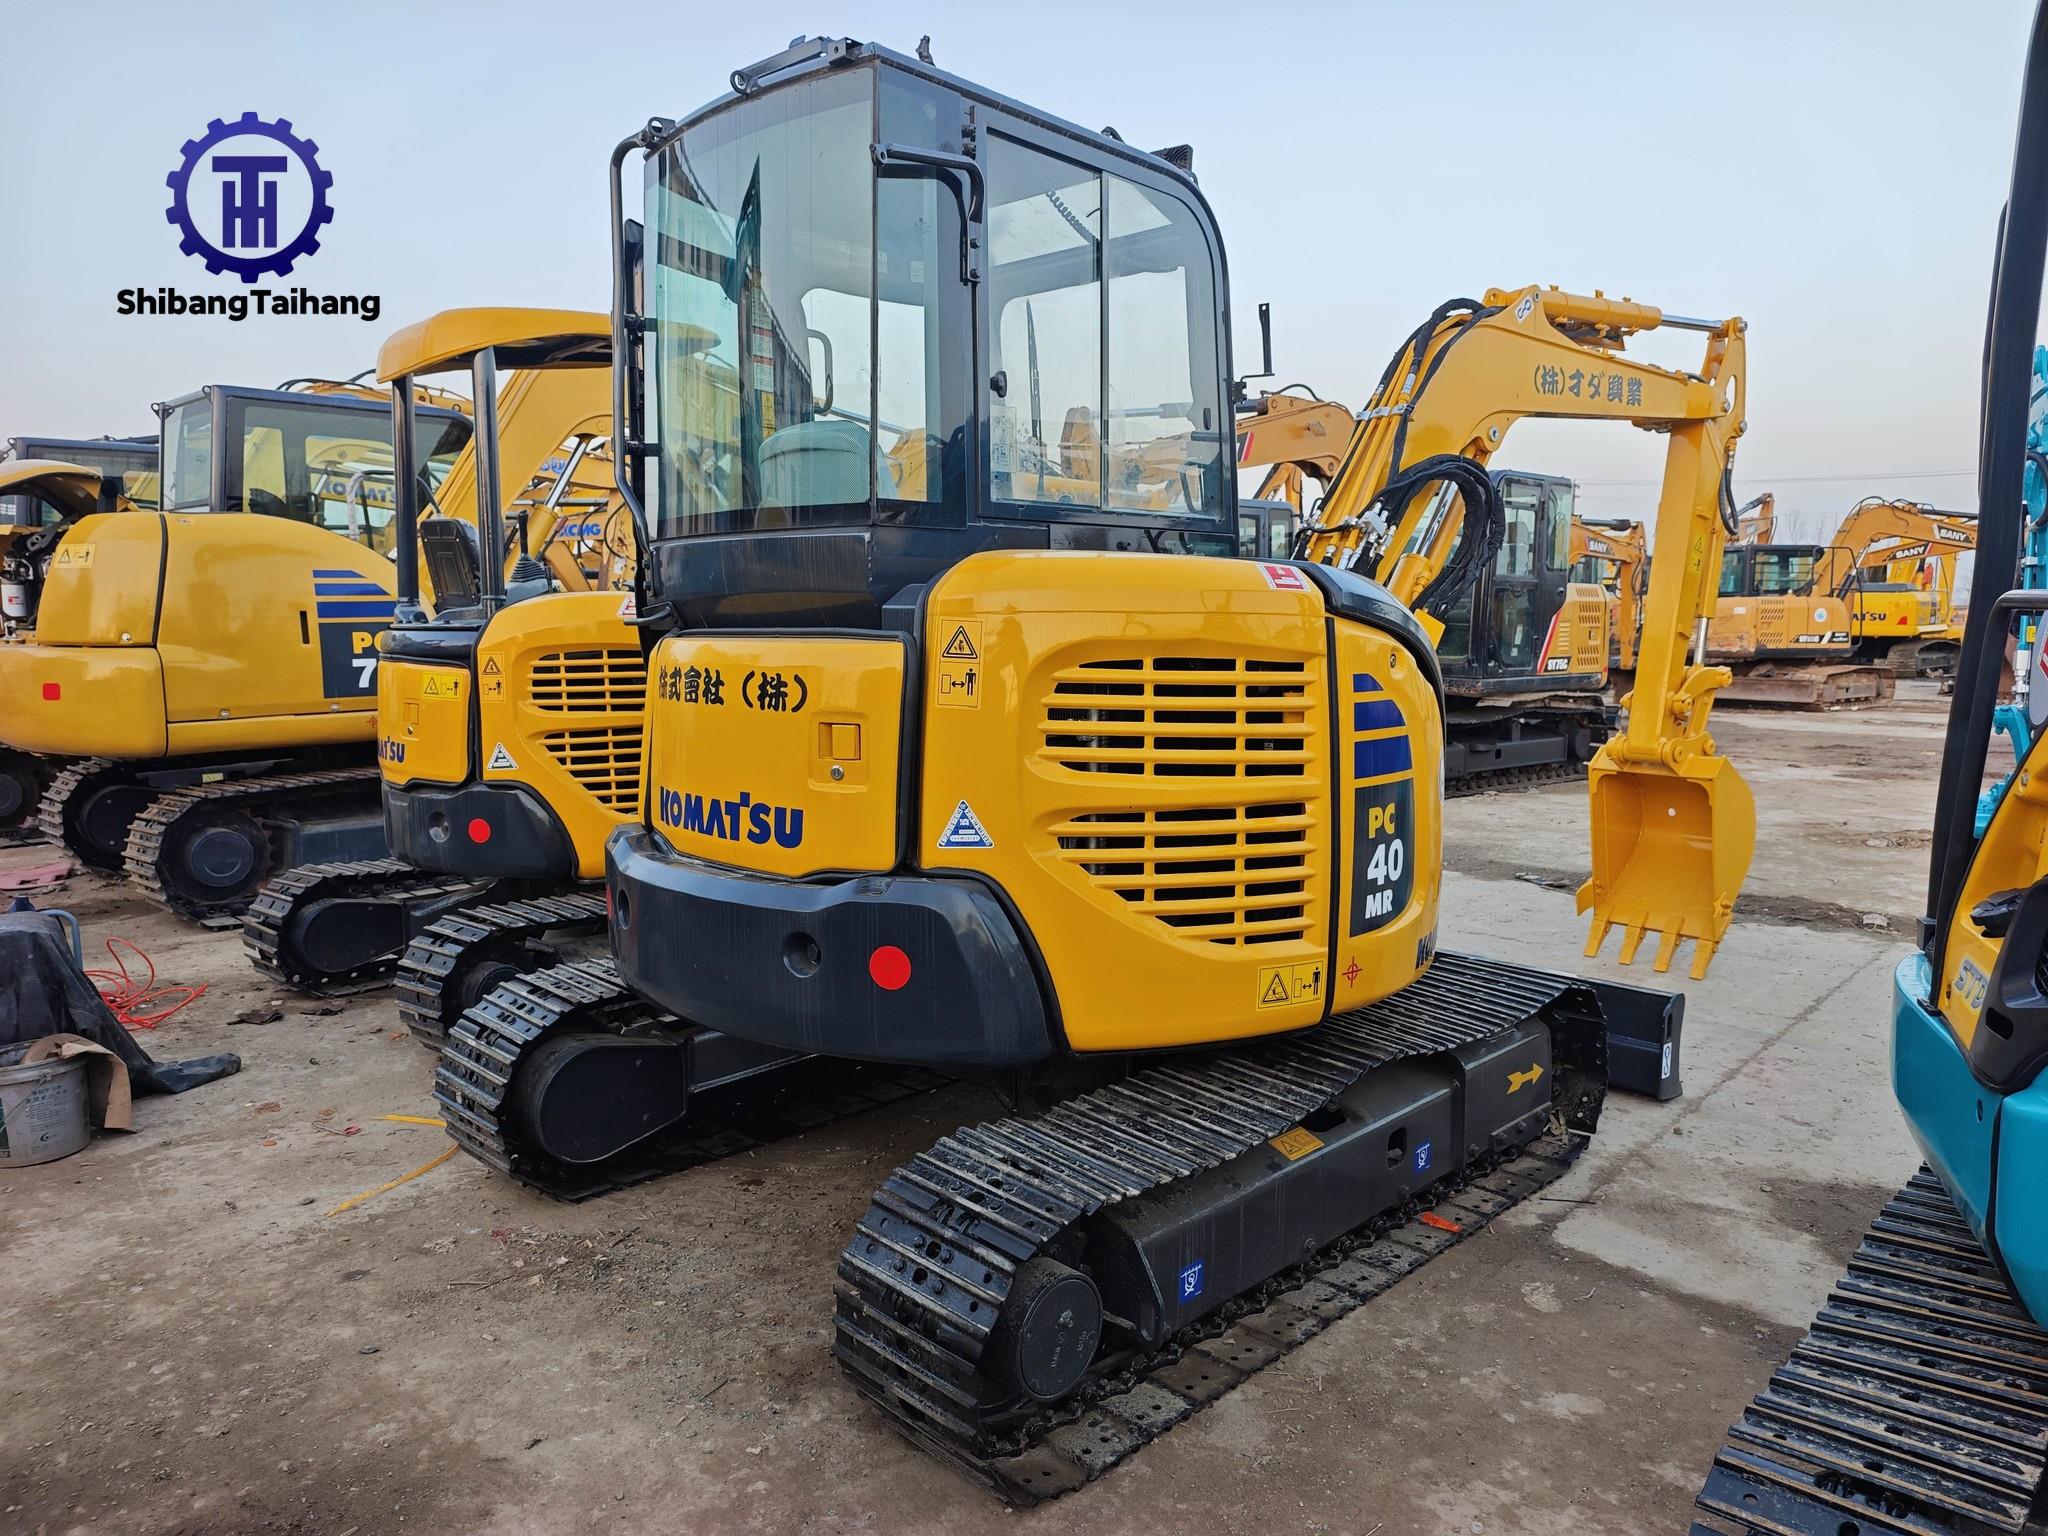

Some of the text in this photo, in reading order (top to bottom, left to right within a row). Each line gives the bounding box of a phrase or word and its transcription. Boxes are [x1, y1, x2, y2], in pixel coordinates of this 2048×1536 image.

[660, 786, 804, 849] KOMATSU
[1368, 802, 1396, 840] PC
[1367, 838, 1404, 886] 40
[1364, 889, 1393, 919] MR
